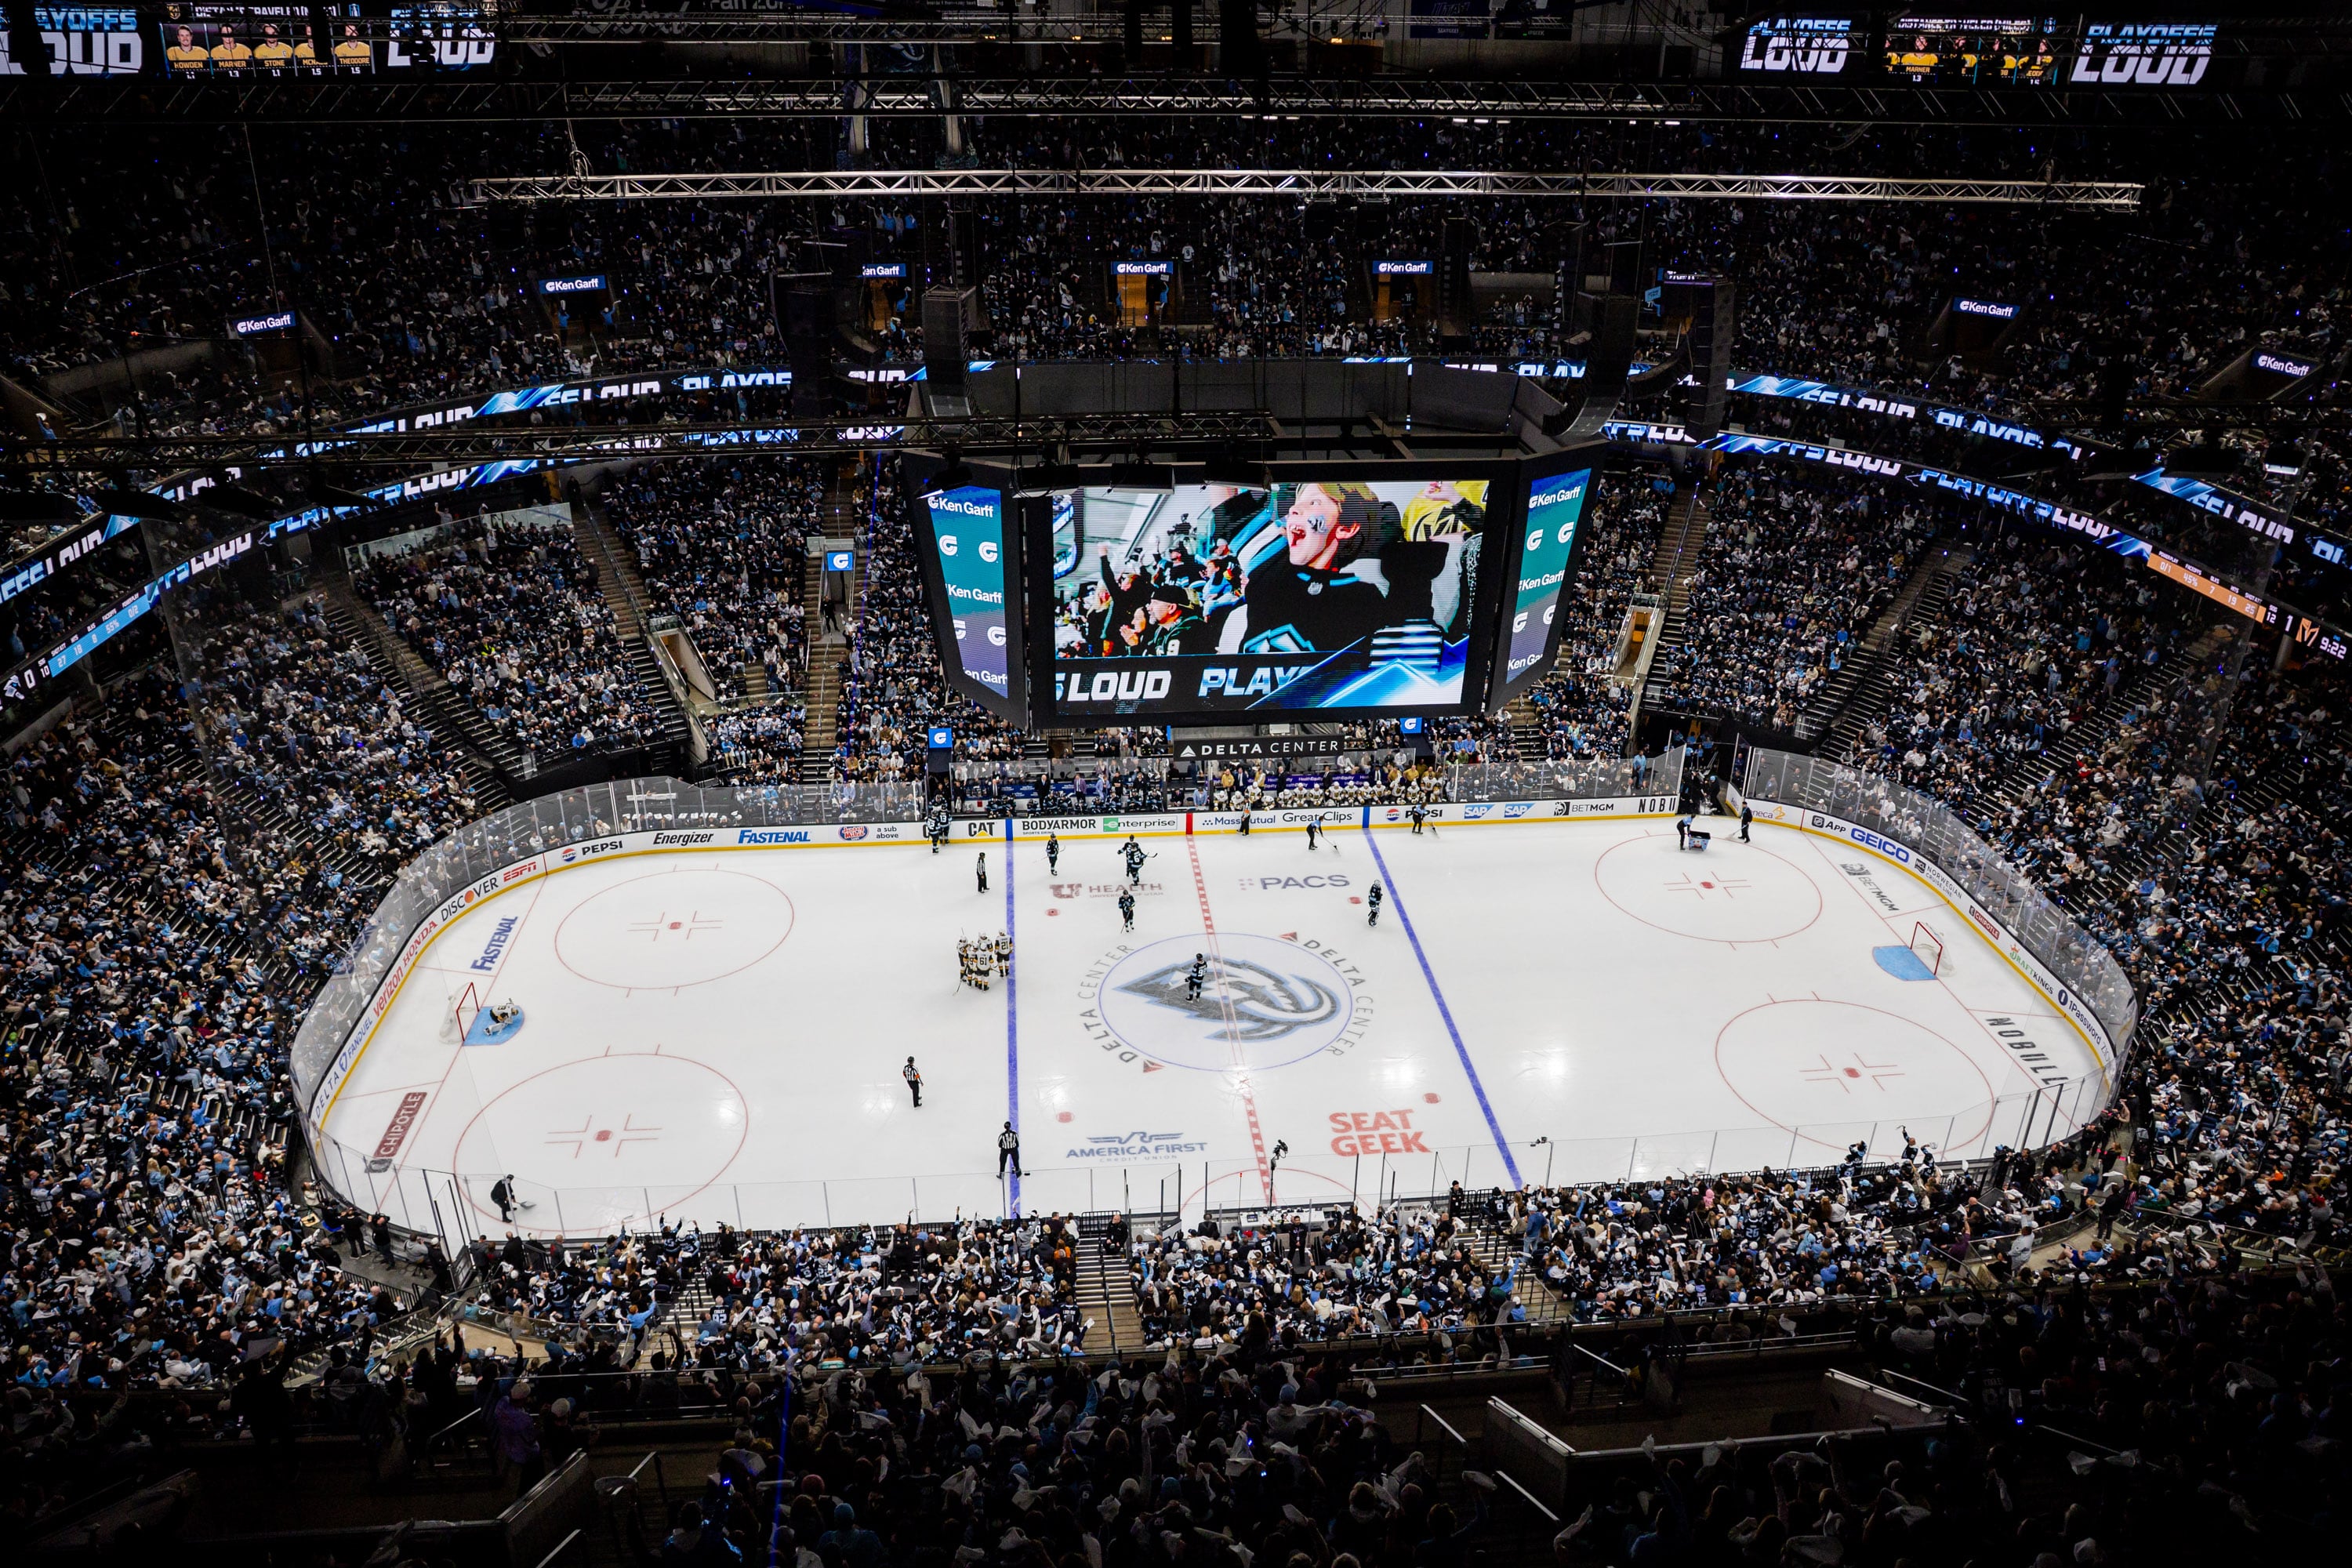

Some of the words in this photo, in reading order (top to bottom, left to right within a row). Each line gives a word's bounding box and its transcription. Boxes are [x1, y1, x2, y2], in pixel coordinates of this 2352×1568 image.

[339, 57, 370, 66] THEODORE
[1740, 36, 1849, 72] LOUD
[1905, 63, 1930, 73] MARNER
[2071, 45, 2212, 84] LOUD
[877, 266, 899, 275] Garff
[1126, 263, 1144, 273] Ken
[1144, 263, 1167, 273] Garff
[1387, 263, 1404, 272] Ken
[1404, 263, 1427, 272] Garff
[555, 281, 574, 291] Ken
[575, 278, 598, 289] Garff
[1969, 302, 1987, 313] Ken
[1988, 305, 2013, 317] Garff
[247, 320, 267, 331] Ken
[267, 314, 291, 328] Garff
[2267, 357, 2285, 372] Ken
[2285, 361, 2310, 376] Garff
[1537, 493, 1556, 507] Ken
[1556, 486, 1581, 503] Garff
[939, 497, 963, 514] Ken
[964, 502, 994, 519] Garff
[1523, 578, 1541, 591] Ken
[2183, 572, 2198, 587] 45%
[948, 583, 972, 599] Ken
[972, 589, 1003, 604] Garff
[2209, 586, 2216, 594] 7
[2228, 594, 2238, 604] 19
[2245, 603, 2256, 615] 25
[2266, 612, 2278, 624] 12
[2285, 615, 2294, 633] 1
[74, 643, 84, 656] 18
[2319, 637, 2347, 659] 9:22
[57, 655, 67, 669] 27
[1507, 658, 1526, 671] Ken
[24, 669, 36, 689] 0
[40, 665, 51, 678] 10
[1067, 670, 1172, 701] LOUD
[1201, 744, 1262, 756] DELTA
[1269, 740, 1338, 753] CENTER
[1465, 806, 1488, 815] SAP
[1504, 805, 1527, 815] SAP
[1571, 804, 1614, 812] BETMGM
[1022, 818, 1097, 832] BODYARMOR
[1111, 818, 1176, 829] enterprise
[1214, 815, 1276, 827] Massutual
[1324, 811, 1352, 824] Clips
[739, 829, 811, 844] FASTENAL
[968, 822, 995, 837] CAT
[653, 831, 714, 847] Energizer
[1850, 827, 1910, 863] GEICO
[582, 840, 623, 856] PEPSI
[503, 862, 536, 883] ESPN
[1089, 883, 1163, 893] HEALTH
[1260, 875, 1350, 890] PACS
[1927, 866, 1962, 899] NORWEGIAN
[1857, 877, 1900, 912] BETMGM
[1974, 910, 2000, 940] CHIPOTLE
[402, 920, 438, 968] HONDA
[470, 916, 518, 971] FASTENAL
[1303, 939, 1367, 987] DELTA
[1077, 943, 1134, 1000] CENTER
[2009, 952, 2053, 995] DRAFTKINGS
[372, 966, 405, 1018] verizon
[1324, 996, 1374, 1058] CENTER
[2069, 1000, 2102, 1047] 1Password
[348, 1018, 374, 1059] FANDUEL
[1079, 1007, 1138, 1064] DELTA
[1984, 1017, 2070, 1085] NOBULL
[315, 1071, 339, 1120] DELTA
[379, 1092, 423, 1157] CHIPOTLE
[1329, 1109, 1414, 1134] SEAT
[1065, 1145, 1151, 1158] AMERICA
[1154, 1142, 1207, 1154] FIRST
[1330, 1131, 1432, 1157] GEEK
